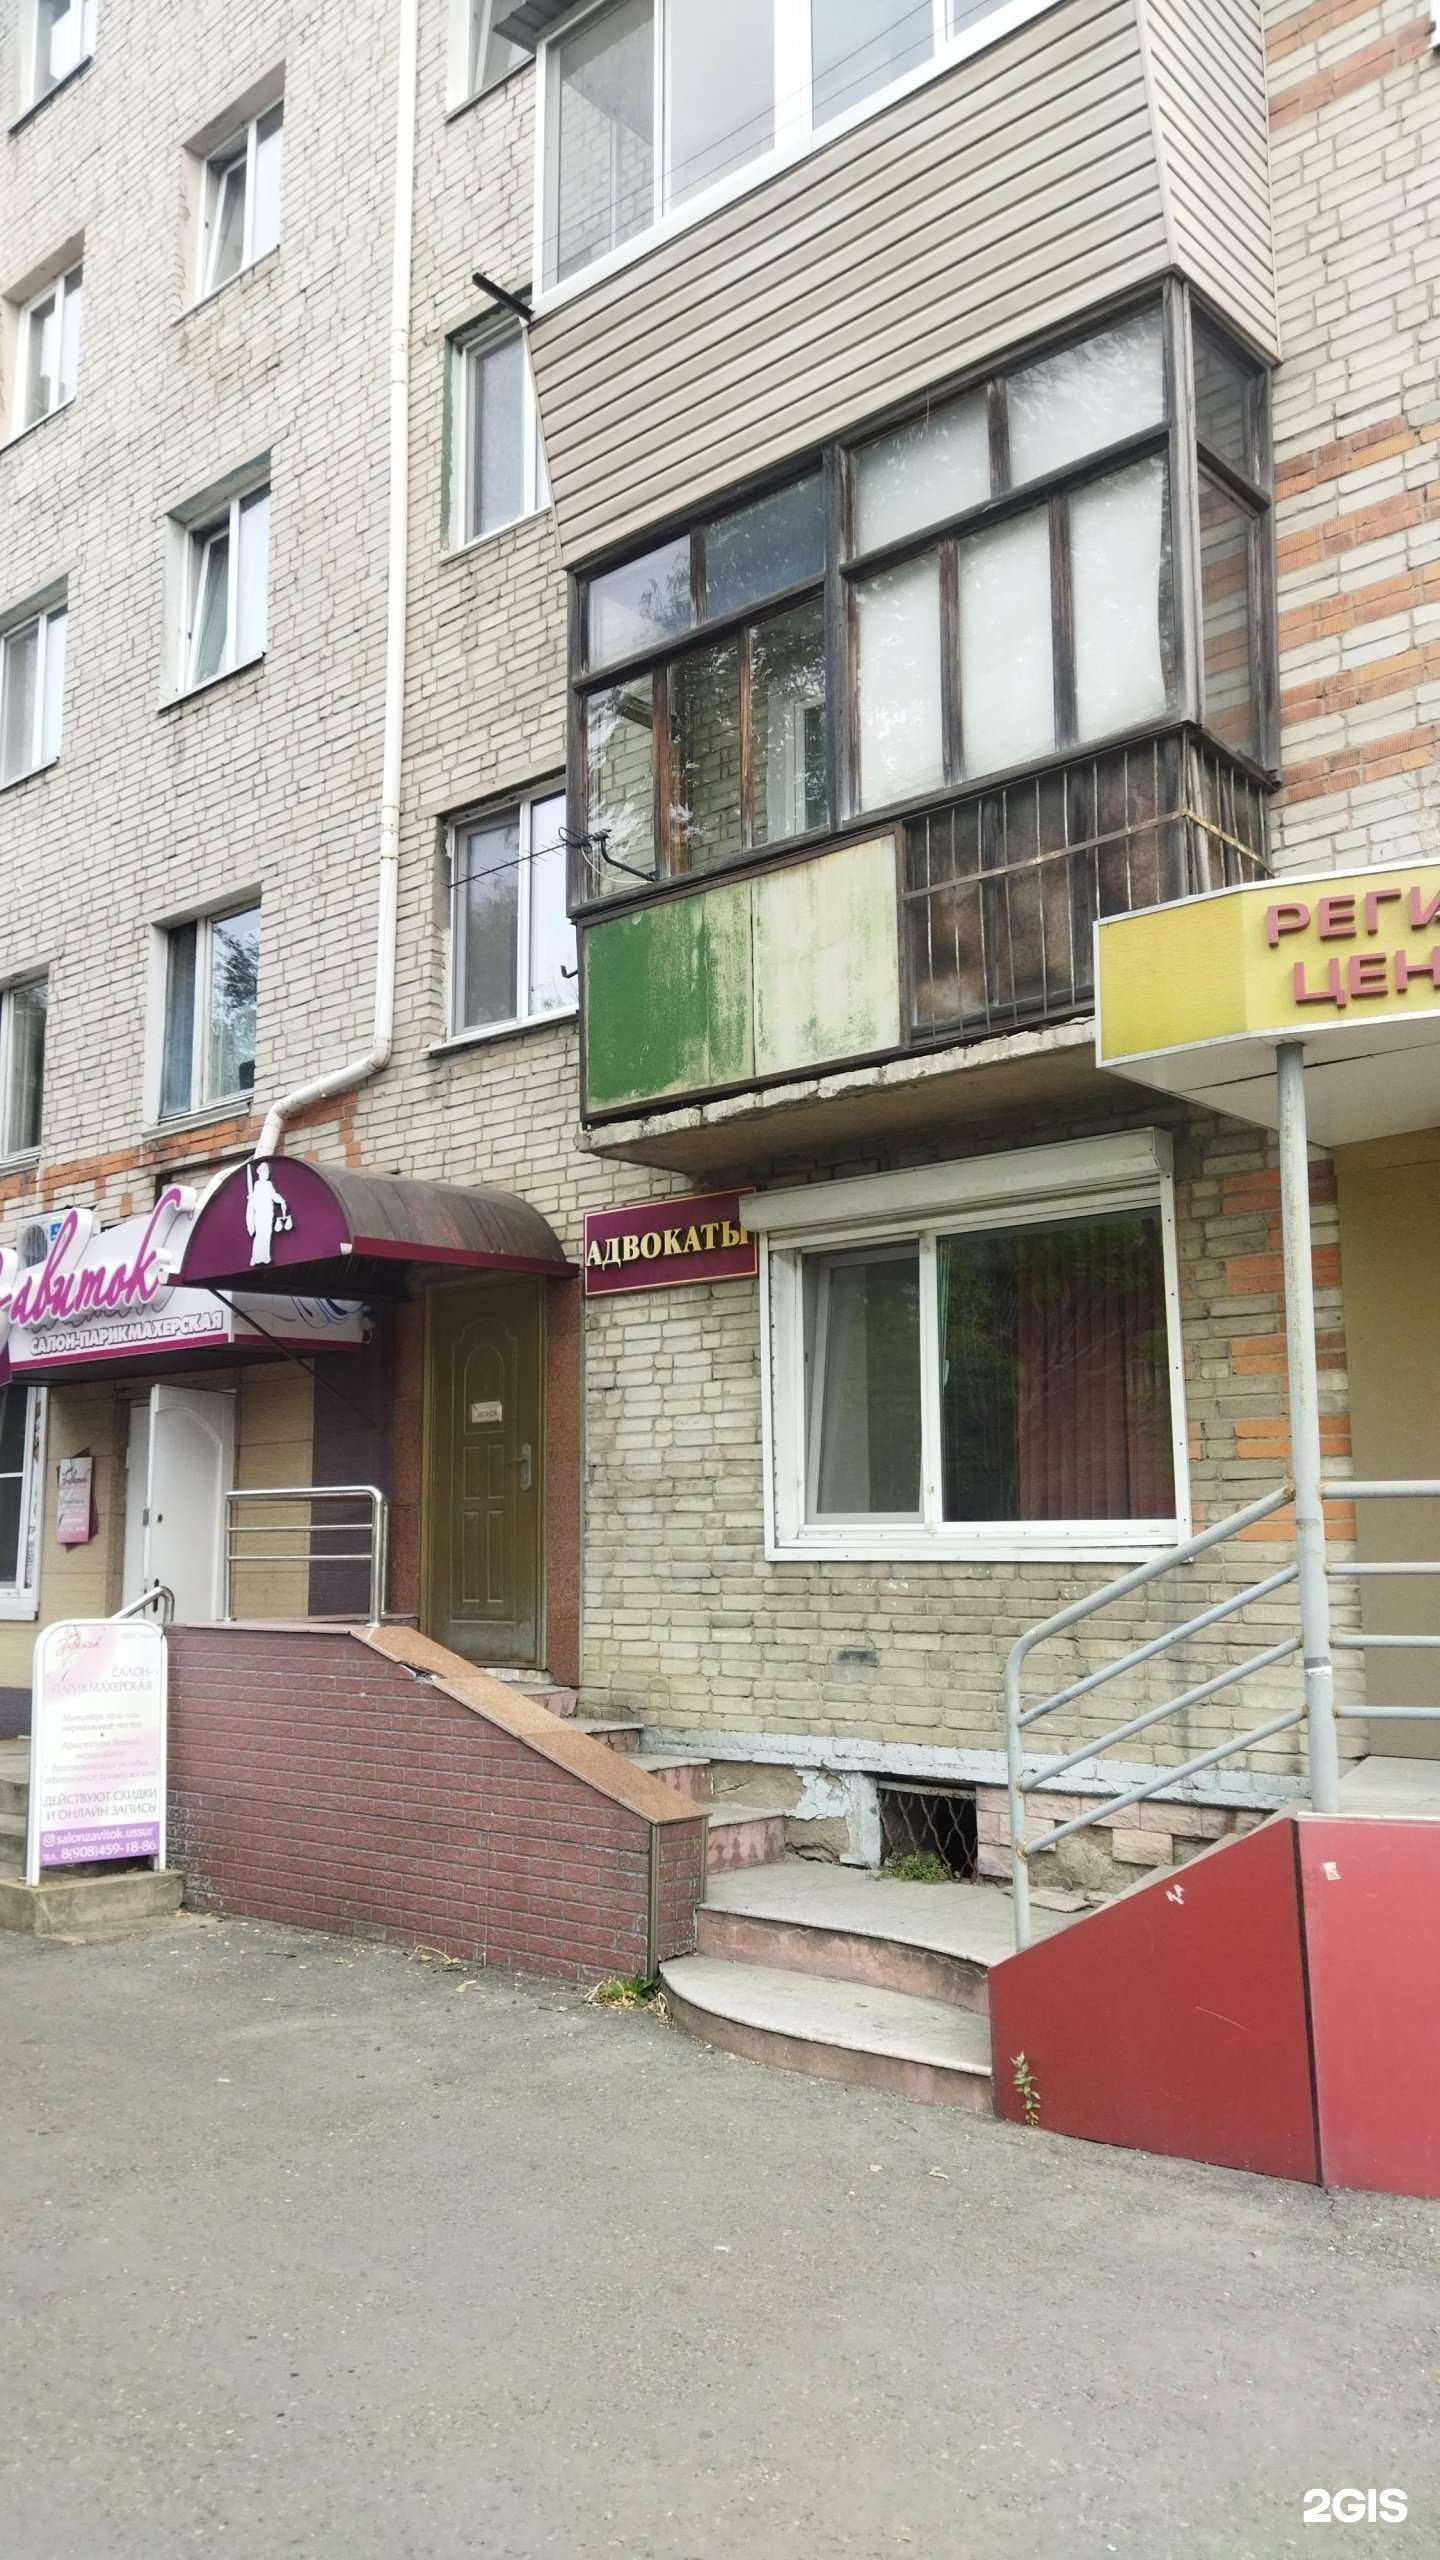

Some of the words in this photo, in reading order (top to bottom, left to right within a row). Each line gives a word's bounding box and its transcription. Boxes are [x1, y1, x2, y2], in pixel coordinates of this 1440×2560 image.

[1294, 946, 1440, 1008] ЦЕН
[0, 1188, 182, 1326] авиток
[586, 1220, 750, 1271] АДВОКАТЫ
[31, 1311, 224, 1356] САЛОН-ПАРИКМАХЕРСКАЯ
[43, 1792, 111, 1807] ДЕЙСТВУЮТ
[113, 1788, 157, 1801] СКИДКИ
[46, 1811, 55, 1821] И
[111, 1803, 157, 1816] ЗАПИСЬ
[61, 1840, 157, 1860] 8(908)459-18-86
